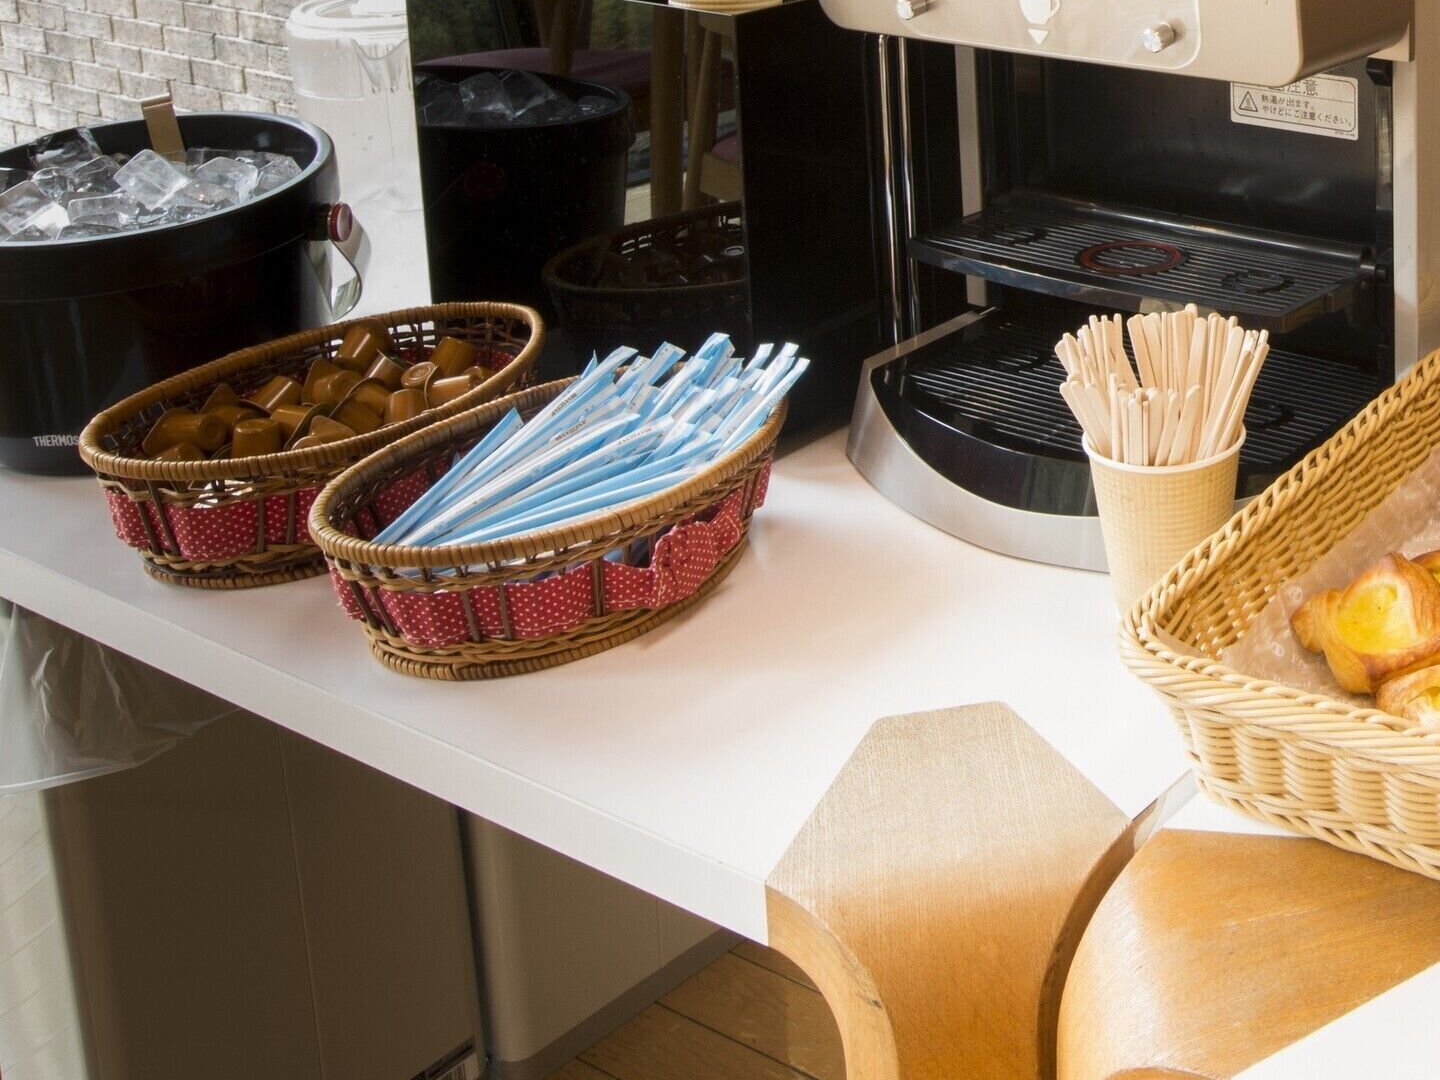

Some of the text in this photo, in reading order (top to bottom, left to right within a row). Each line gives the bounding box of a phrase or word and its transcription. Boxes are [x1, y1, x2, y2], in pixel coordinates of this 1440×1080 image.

[1261, 94, 1315, 111] 熱湯が出ます。
[1261, 105, 1353, 127] やけどにご注意ください。
